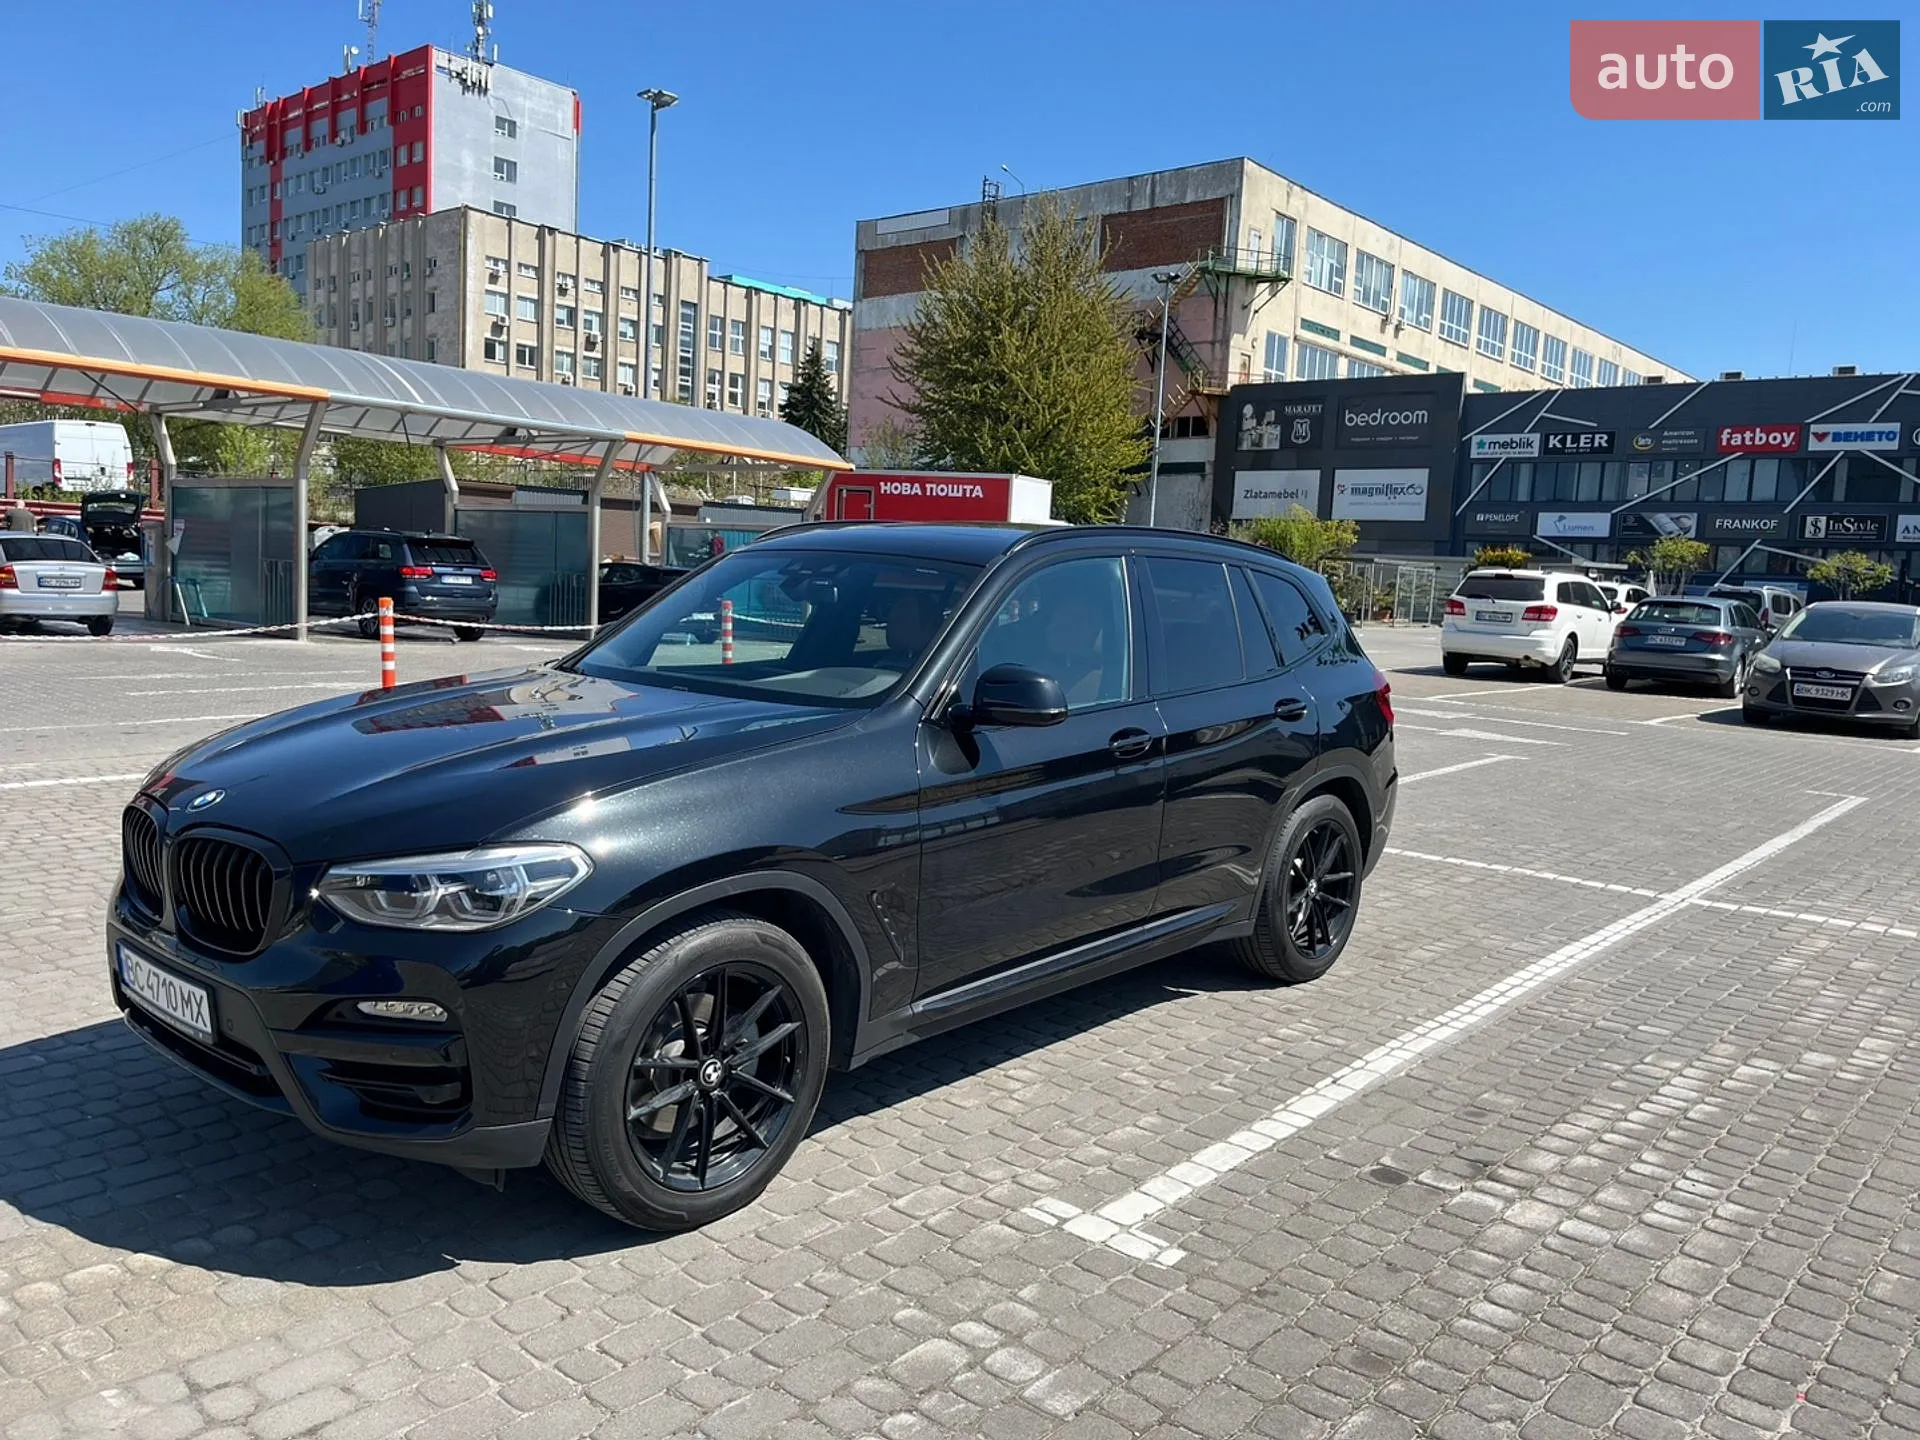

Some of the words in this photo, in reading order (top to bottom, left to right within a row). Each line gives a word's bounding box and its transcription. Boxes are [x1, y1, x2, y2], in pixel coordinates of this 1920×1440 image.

[1345, 407, 1428, 426] bedroom
[1488, 437, 1534, 450] meblik
[1548, 433, 1609, 448] KLER
[1720, 427, 1794, 448] fatboy
[879, 481, 923, 496] НОВА
[925, 482, 984, 498] ПОШТА
[1243, 488, 1299, 500] Zlatamebel
[1715, 518, 1779, 529] FRANKOF
[1828, 517, 1879, 534] InStyle
[124, 952, 145, 992] BC
[146, 968, 178, 1013] 4710
[179, 985, 207, 1028] MX
